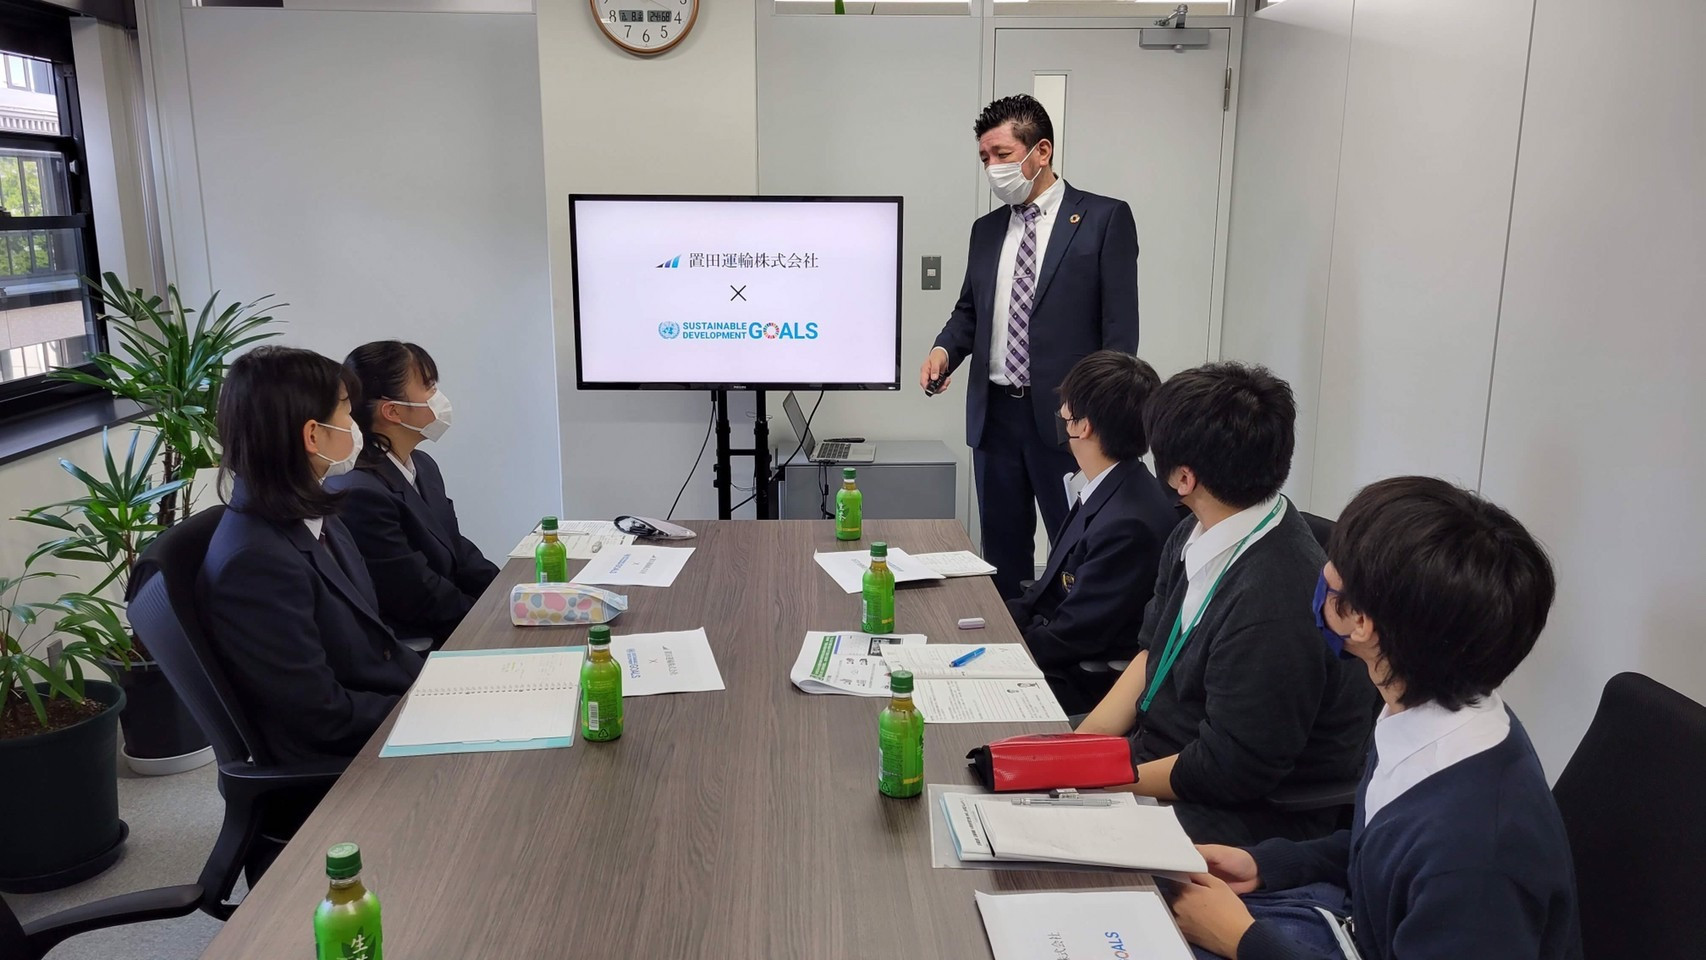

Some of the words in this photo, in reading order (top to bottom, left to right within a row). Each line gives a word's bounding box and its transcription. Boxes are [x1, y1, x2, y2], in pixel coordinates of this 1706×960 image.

[609, 10, 617, 23] 8
[674, 11, 683, 24] 4
[624, 25, 632, 38] 7
[642, 29, 650, 43] 6
[660, 25, 668, 38] 5
[689, 252, 819, 269] 置田運輸株式会社
[683, 322, 747, 330] SUSTAINABLE
[749, 322, 819, 340] GOALS
[683, 331, 747, 340] DEVELOPMENT
